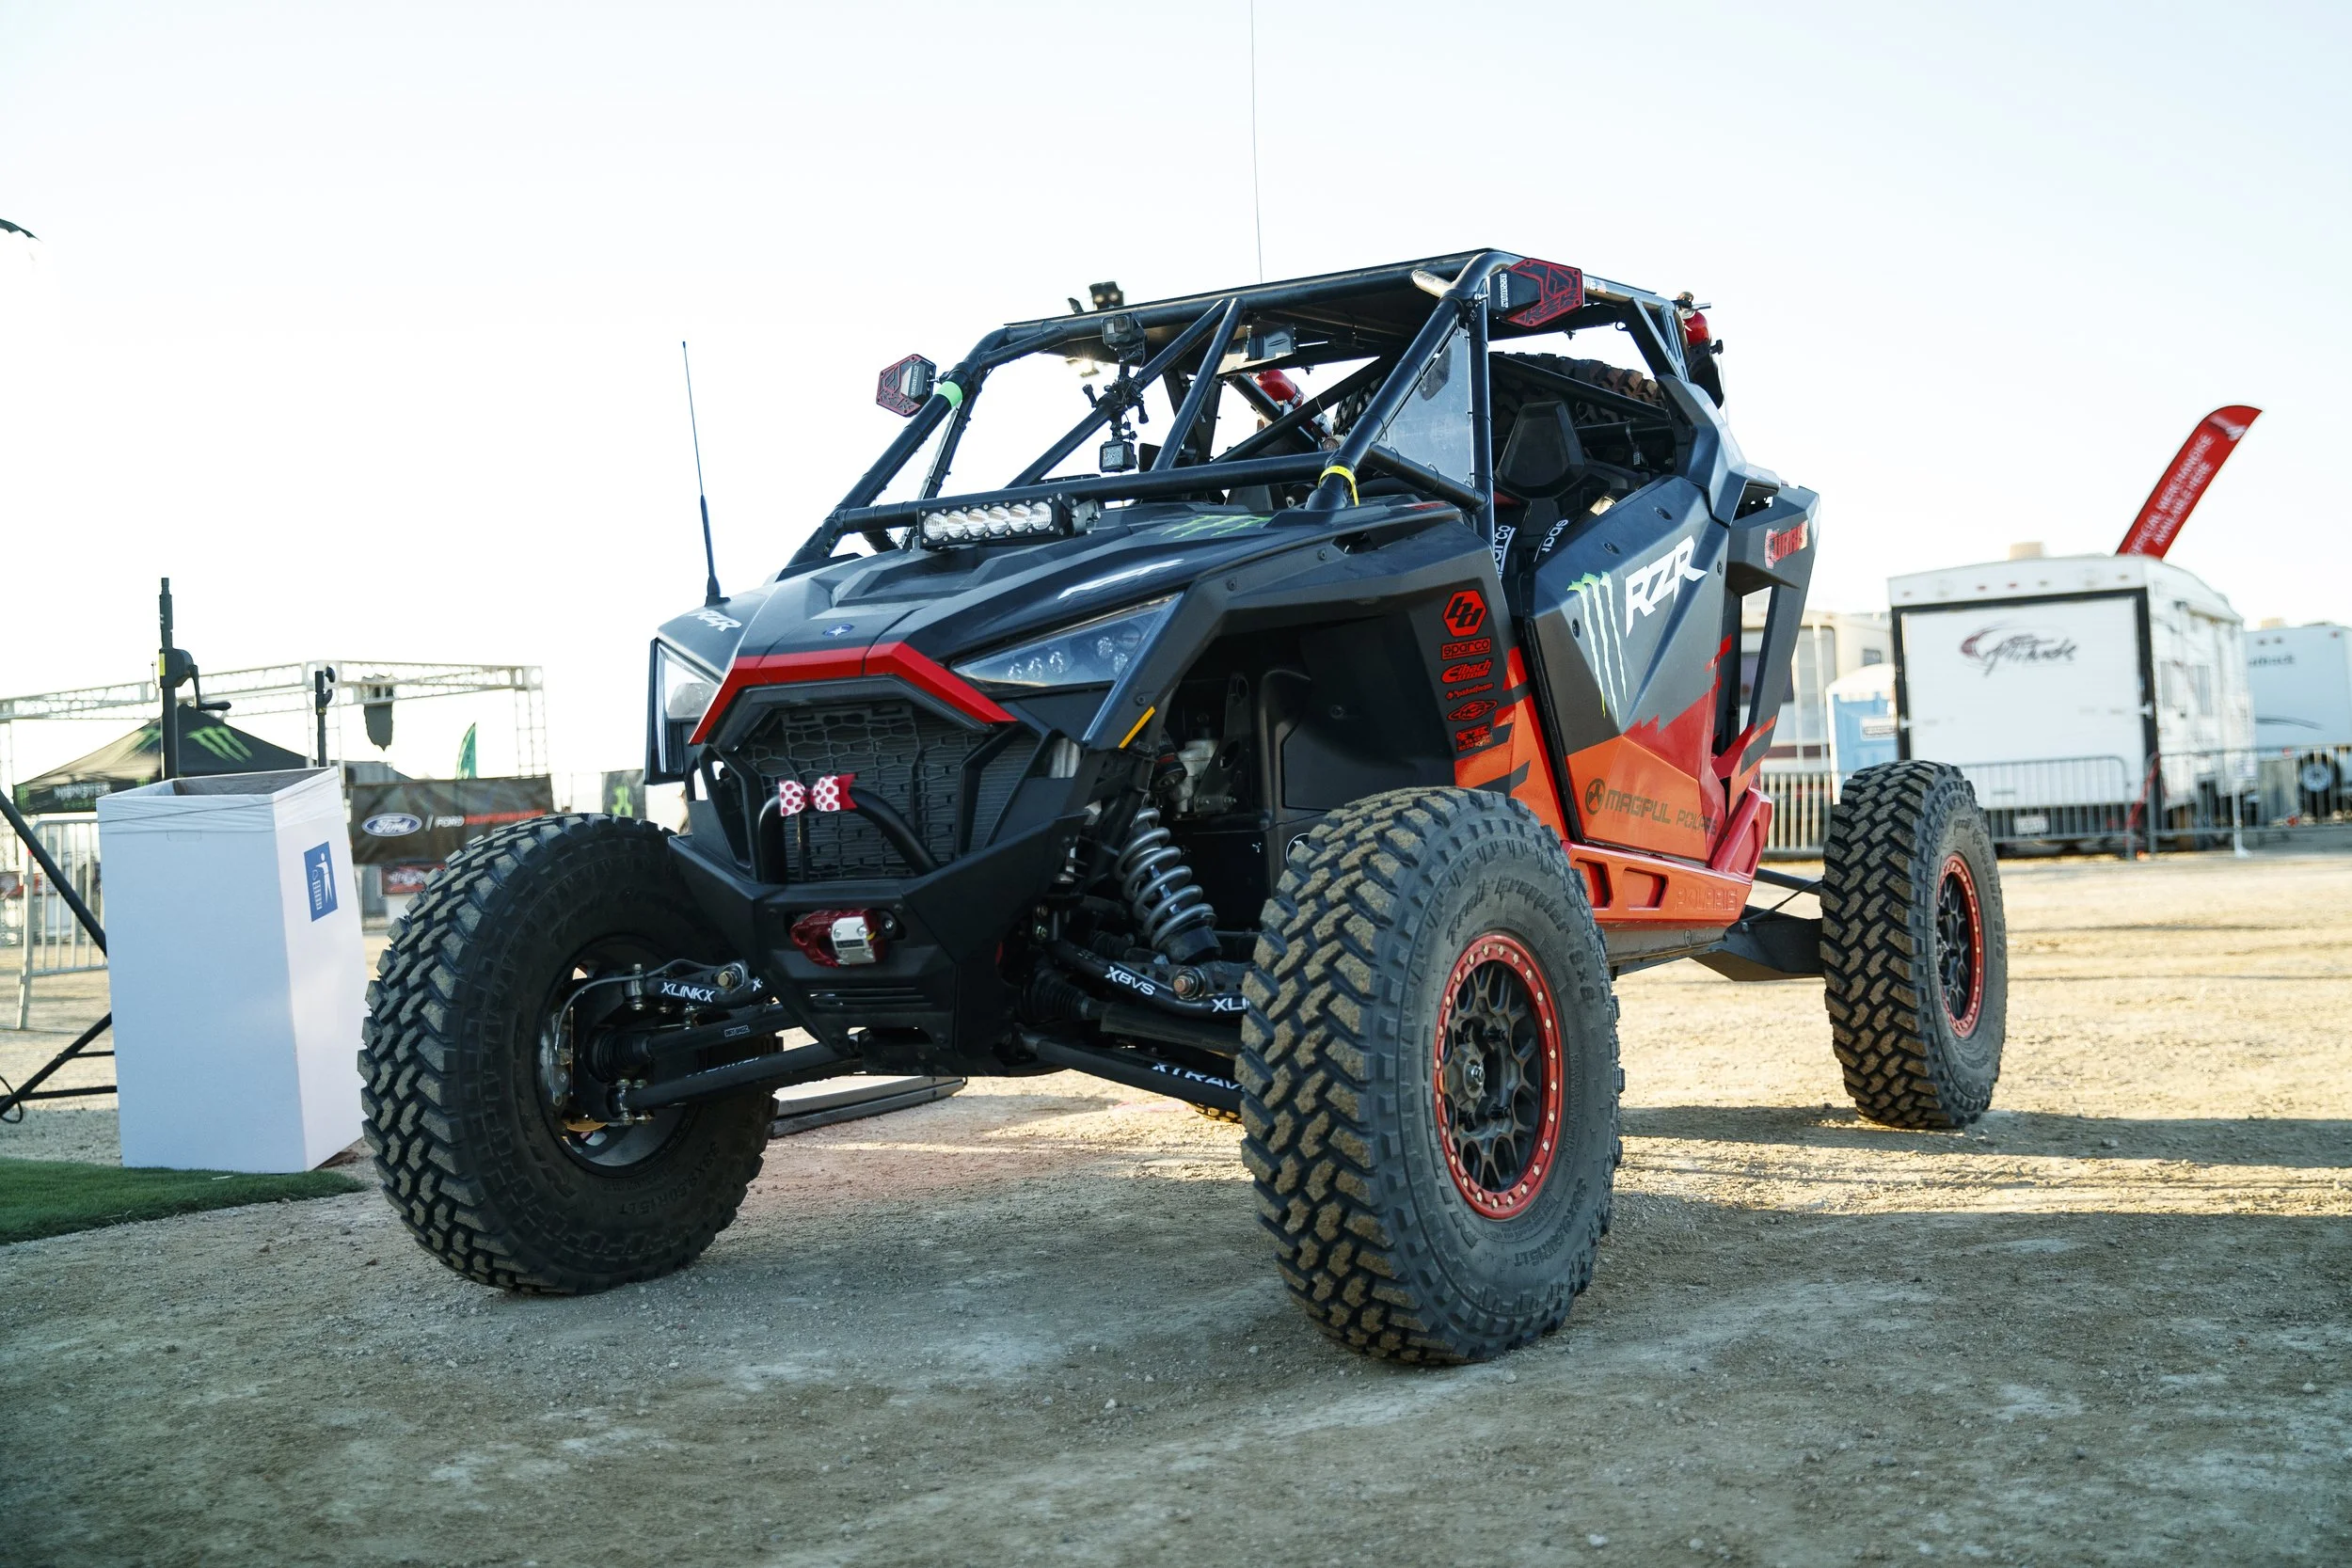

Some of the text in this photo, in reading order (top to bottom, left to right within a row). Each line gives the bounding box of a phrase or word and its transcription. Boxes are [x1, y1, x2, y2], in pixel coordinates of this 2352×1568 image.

[1625, 535, 1708, 639] RZR
[1443, 641, 1489, 656] sparco
[1441, 659, 1491, 683] Eibach
[1604, 788, 1718, 835] MAGPUL POLARIS
[373, 816, 411, 833] Ford
[1675, 887, 1738, 911] POLARIS
[661, 982, 715, 1003] XLINKX
[1104, 965, 1156, 996] XBVS
